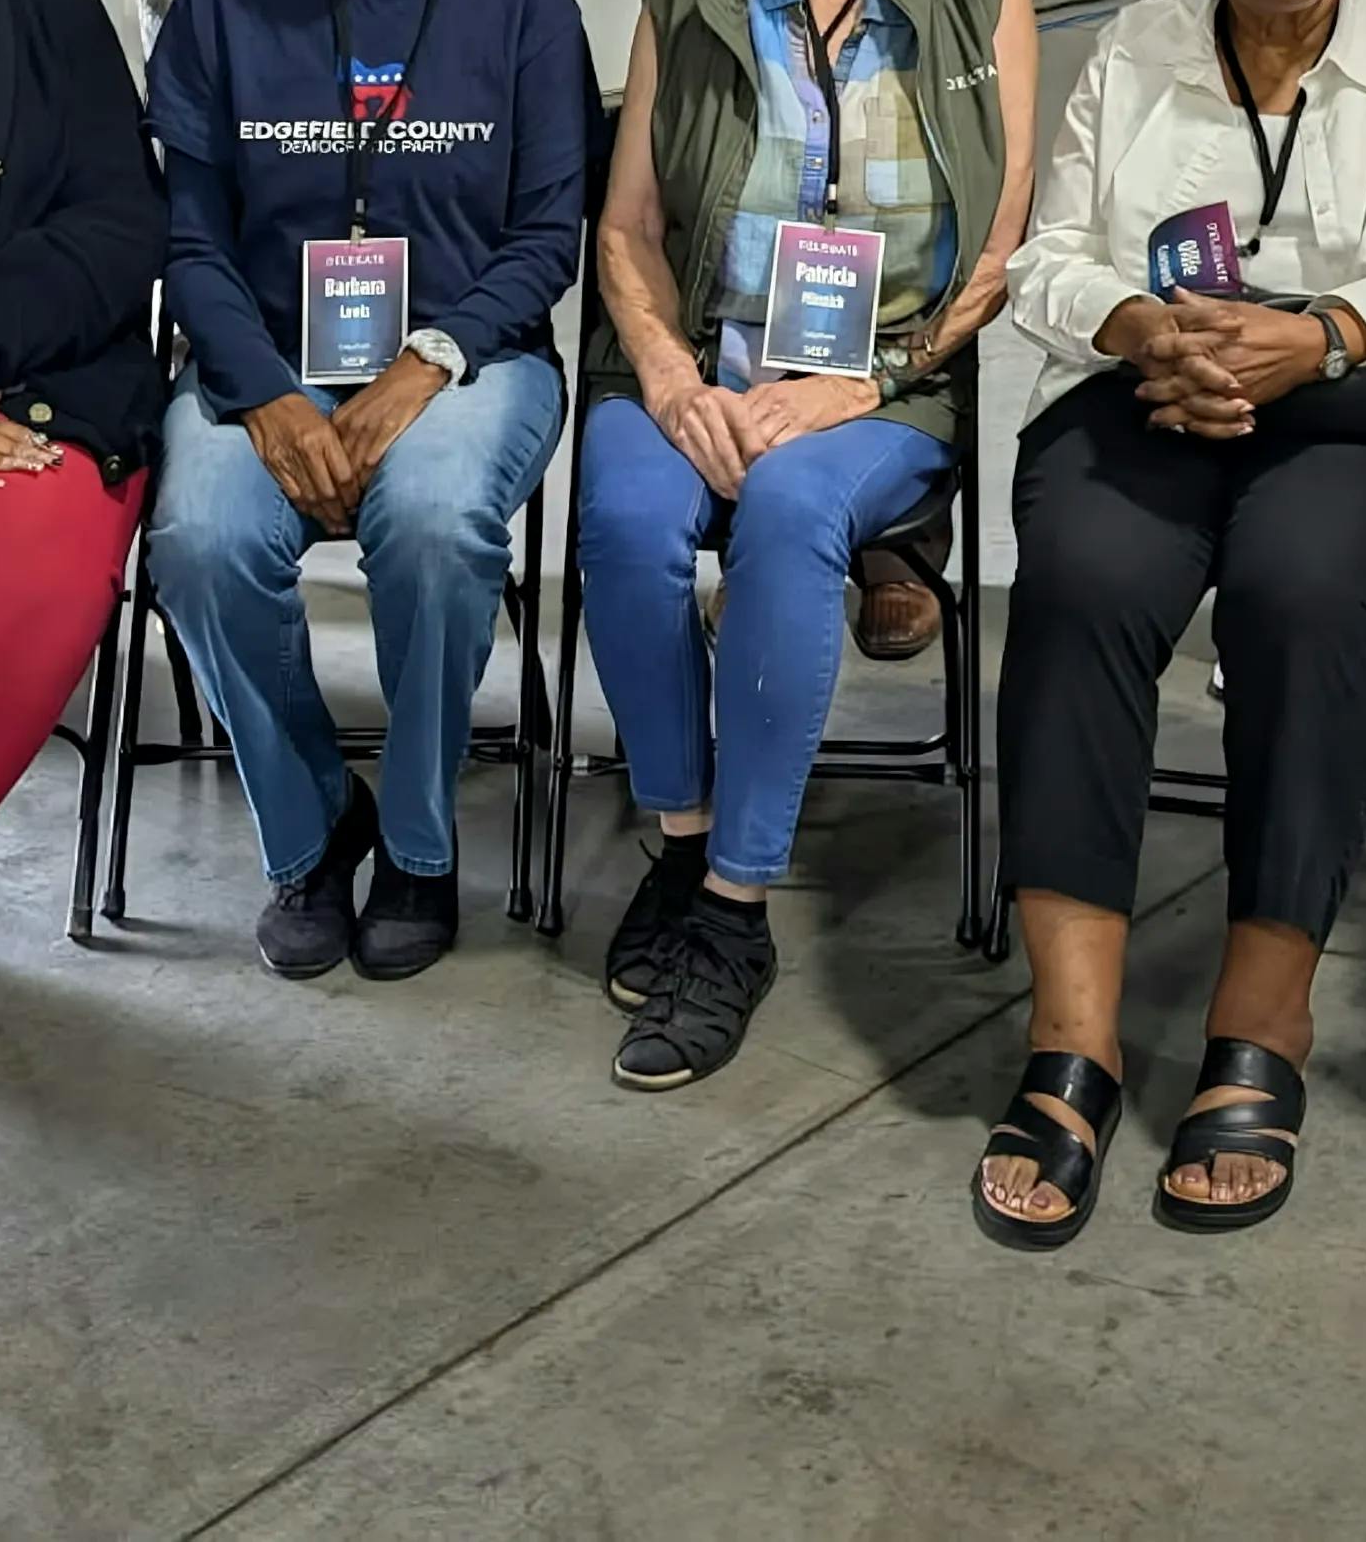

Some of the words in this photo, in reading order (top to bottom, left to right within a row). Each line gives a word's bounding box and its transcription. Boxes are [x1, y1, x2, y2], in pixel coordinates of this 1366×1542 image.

[387, 120, 495, 141] COUNTY
[401, 139, 455, 154] PARTY
[796, 261, 857, 288] Patricia
[325, 276, 386, 298] Barbara
